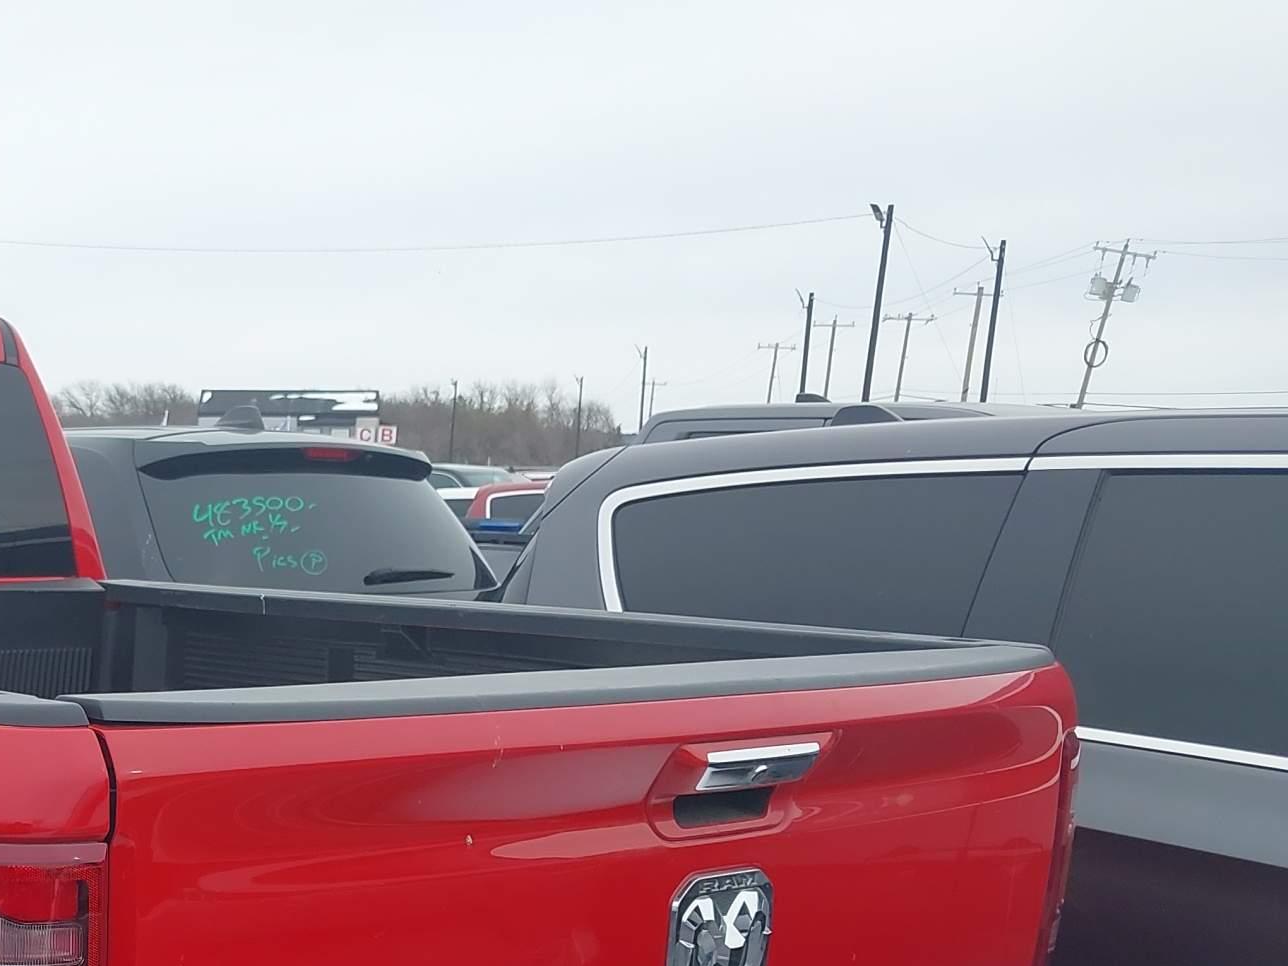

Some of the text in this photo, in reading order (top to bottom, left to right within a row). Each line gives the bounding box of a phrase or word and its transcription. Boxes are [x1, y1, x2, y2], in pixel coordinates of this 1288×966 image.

[359, 428, 372, 442] C
[381, 428, 393, 442] B
[698, 875, 758, 894] RAM
